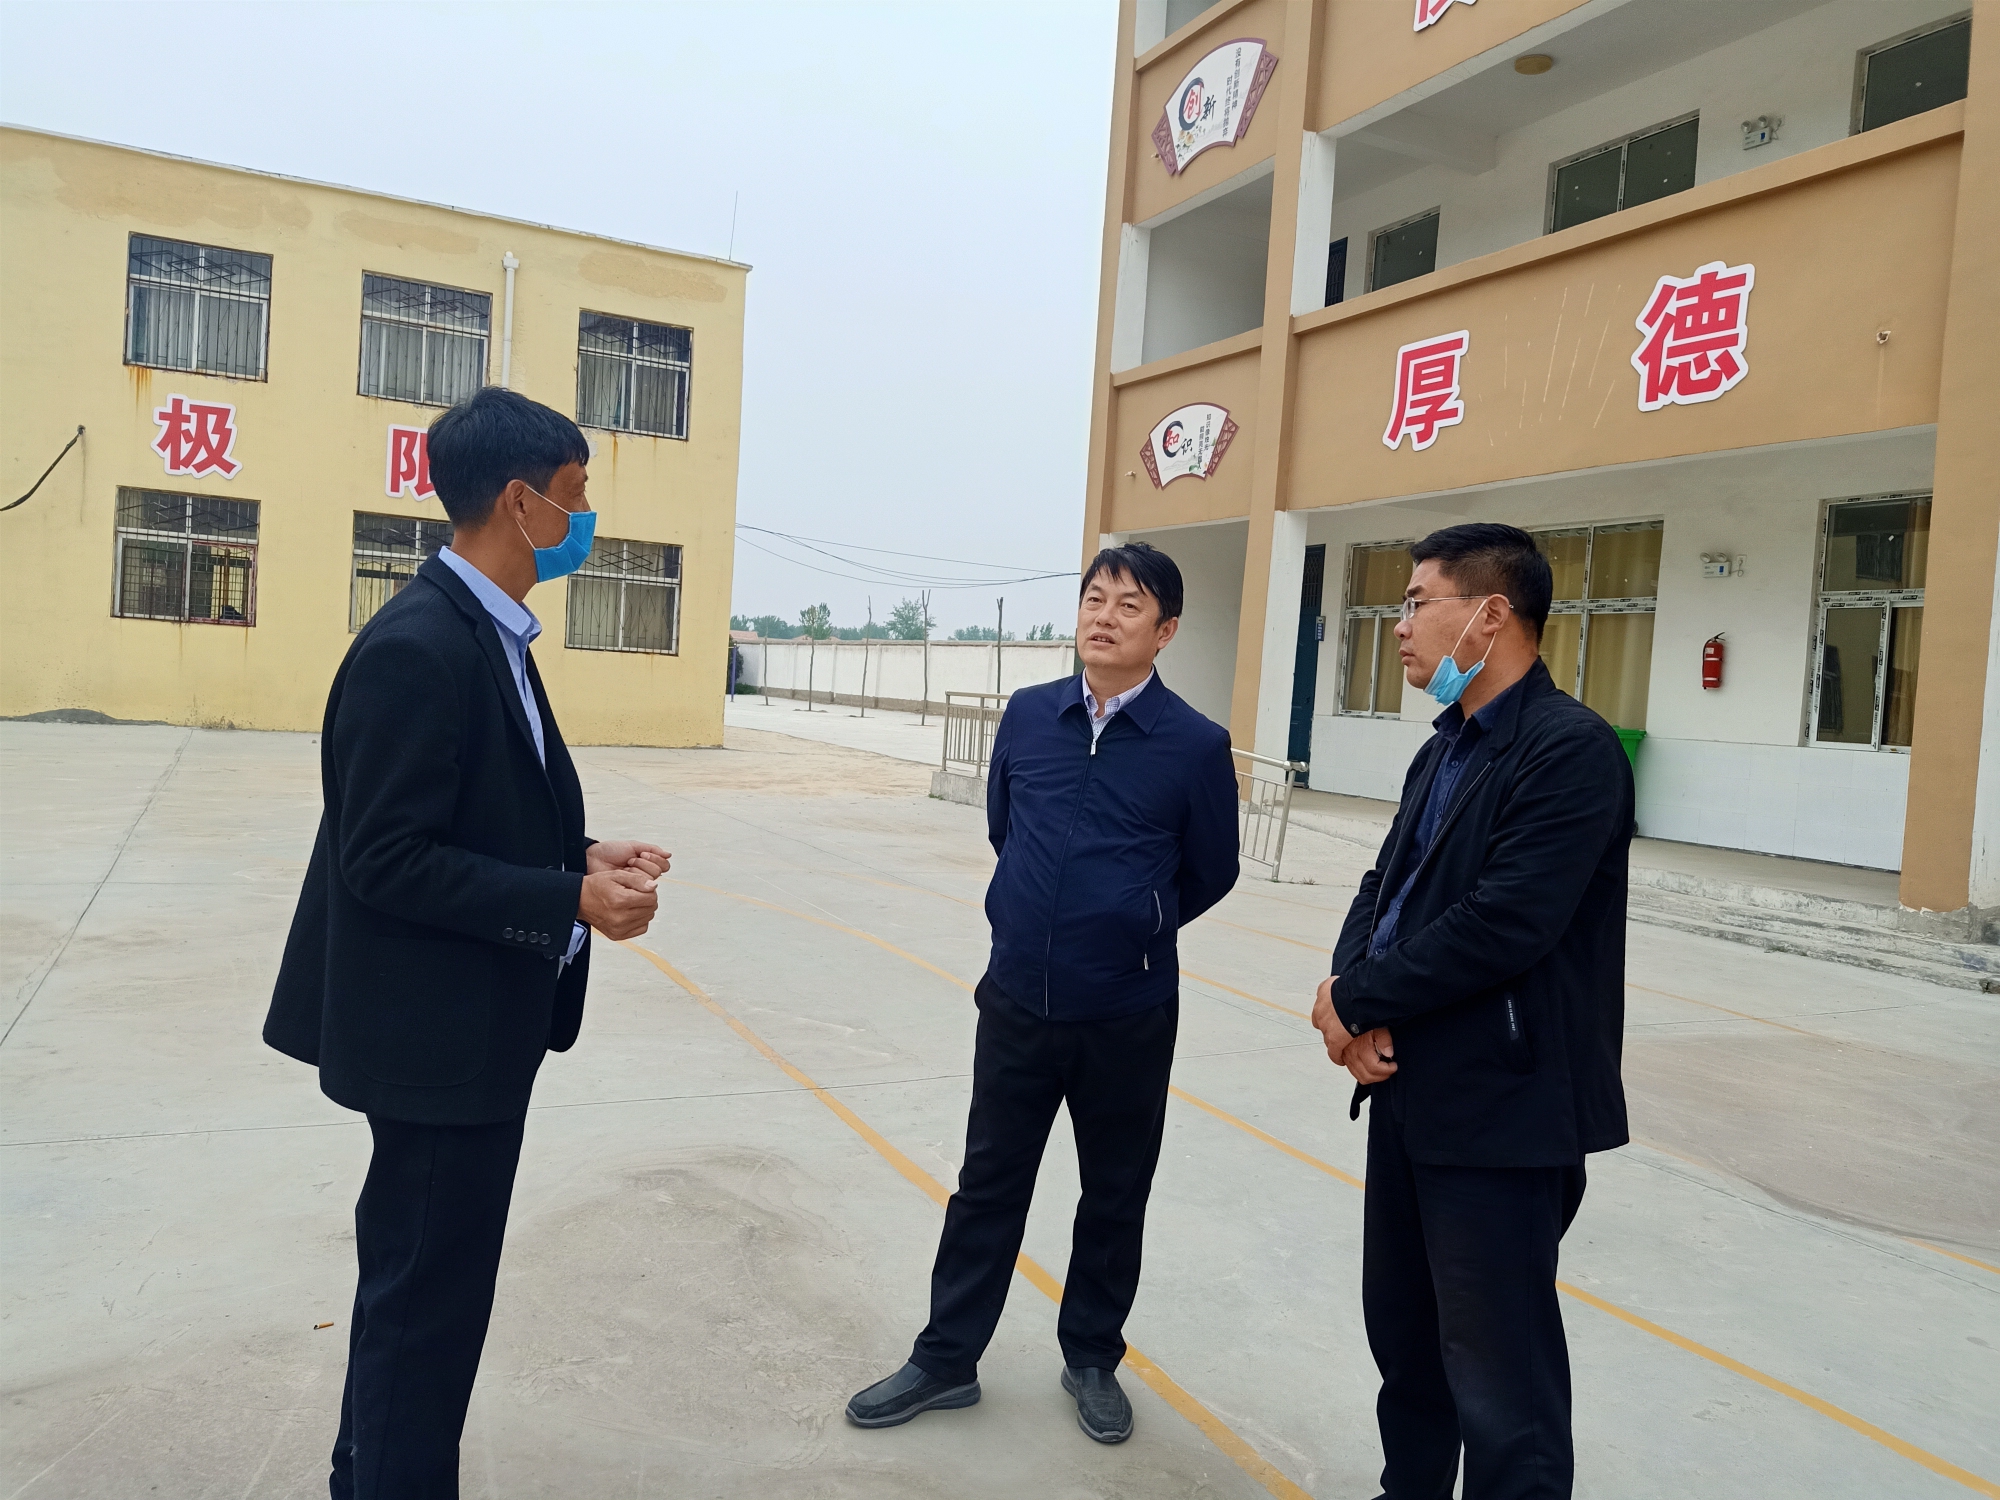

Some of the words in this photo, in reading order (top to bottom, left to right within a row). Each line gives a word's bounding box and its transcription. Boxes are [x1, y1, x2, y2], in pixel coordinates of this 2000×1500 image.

[1231, 47, 1242, 110] 没有创新精神
[1386, 335, 1466, 446] 厚
[1636, 268, 1750, 407] 德
[155, 396, 239, 476] 极
[1163, 428, 1193, 456] 知识
